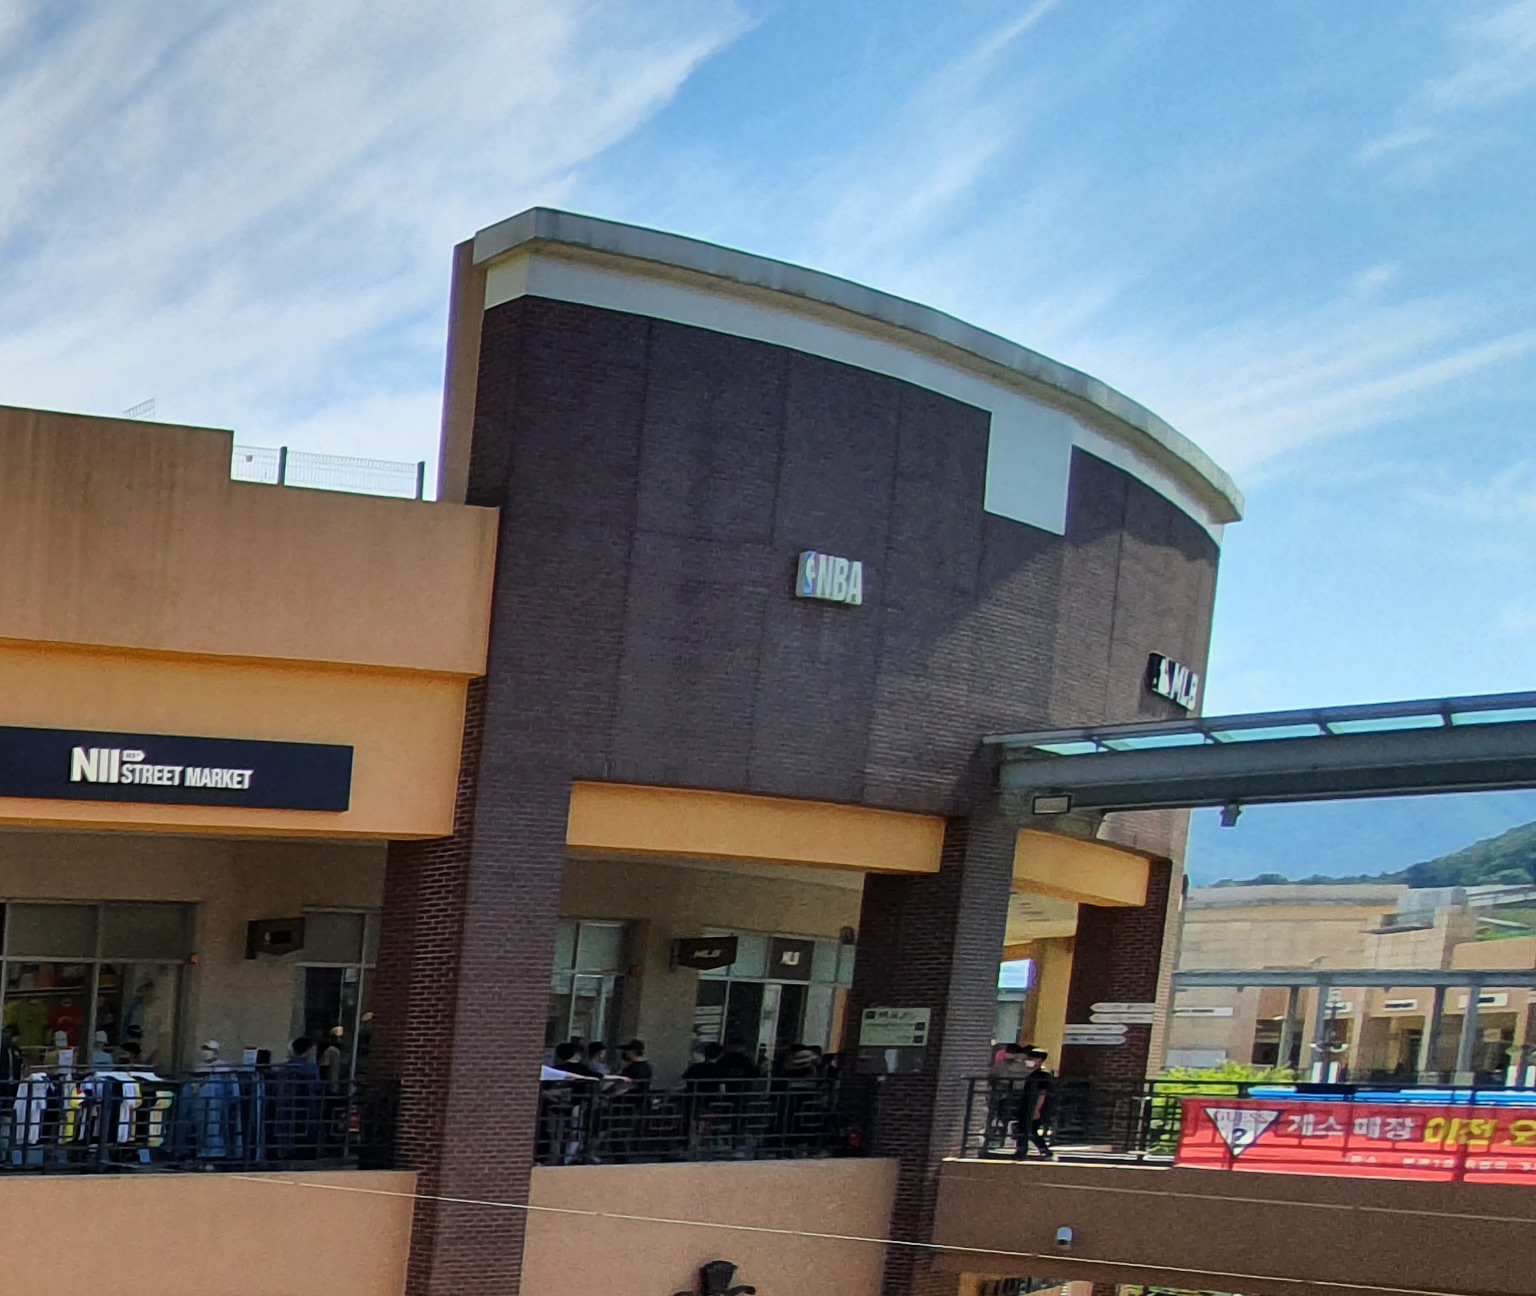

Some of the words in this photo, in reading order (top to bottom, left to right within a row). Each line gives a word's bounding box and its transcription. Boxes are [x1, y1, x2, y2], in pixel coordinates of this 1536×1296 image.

[816, 554, 862, 605] NBA
[1170, 662, 1199, 711] MLB
[70, 747, 120, 783] NII
[121, 764, 183, 786] STREET
[184, 767, 254, 790] MARKET
